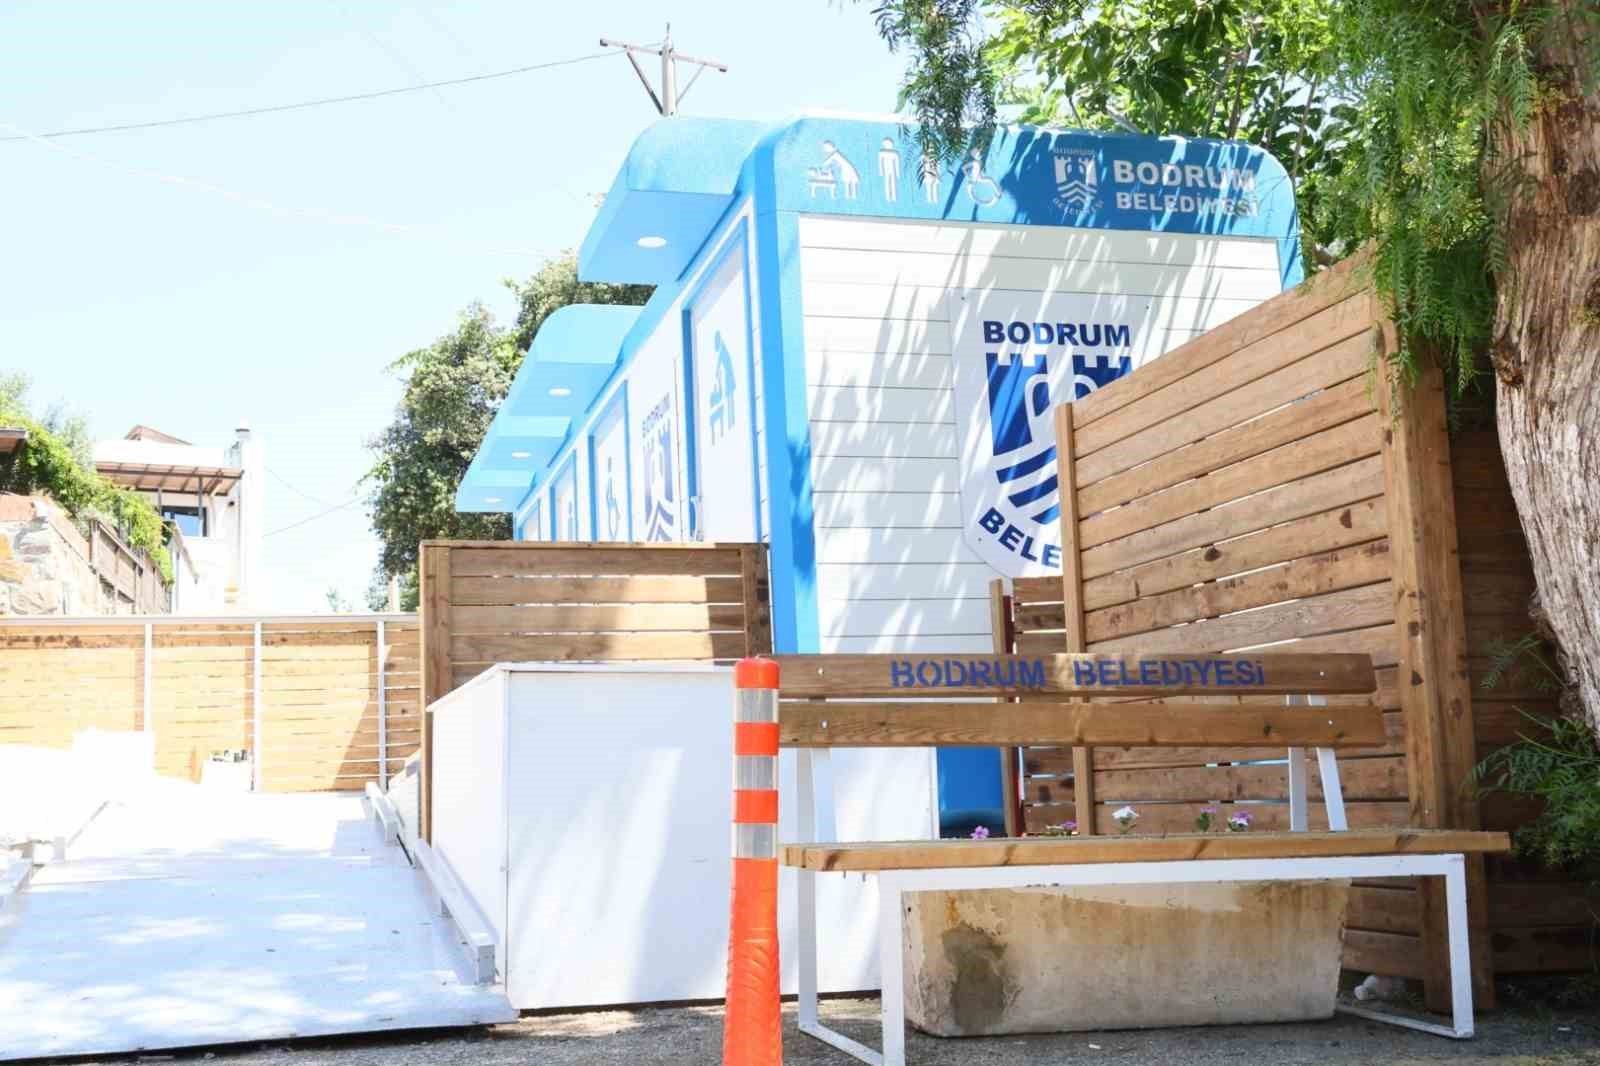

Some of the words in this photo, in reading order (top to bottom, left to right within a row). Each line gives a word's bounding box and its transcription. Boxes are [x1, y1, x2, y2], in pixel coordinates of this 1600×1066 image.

[1113, 160, 1256, 192] BODRUM
[983, 320, 1131, 347] BODRUM
[891, 659, 1046, 688] BODRUM
